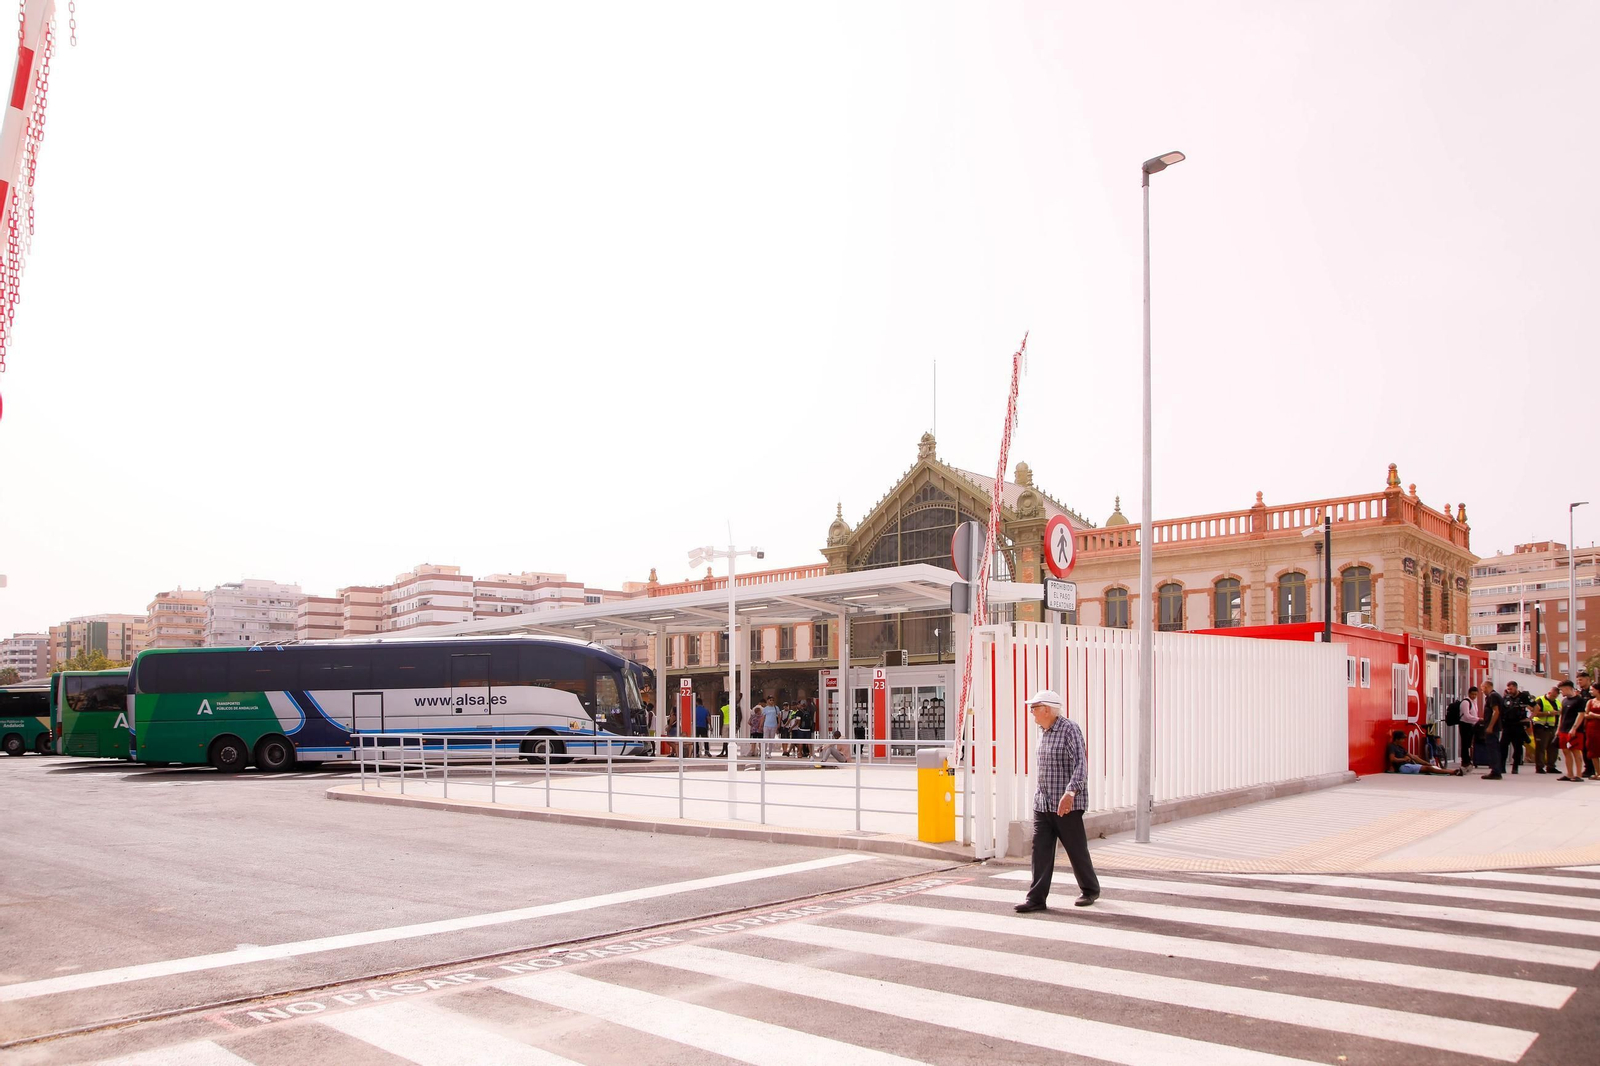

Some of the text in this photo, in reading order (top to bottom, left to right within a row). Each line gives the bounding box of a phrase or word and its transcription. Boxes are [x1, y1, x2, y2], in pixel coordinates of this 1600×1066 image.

[1050, 582, 1074, 592] PROHIBIDO
[1053, 591, 1071, 601] EL PASO
[1053, 601, 1074, 610] PEATONES
[877, 669, 883, 678] D
[874, 681, 885, 690] 23
[680, 689, 691, 697] 22
[414, 693, 508, 707] www.alsa.es
[834, 879, 955, 905] NO PASAR
[689, 905, 838, 936] NO PASAR
[500, 936, 685, 974] NO PASAR
[246, 971, 492, 1024] NO PASAR
